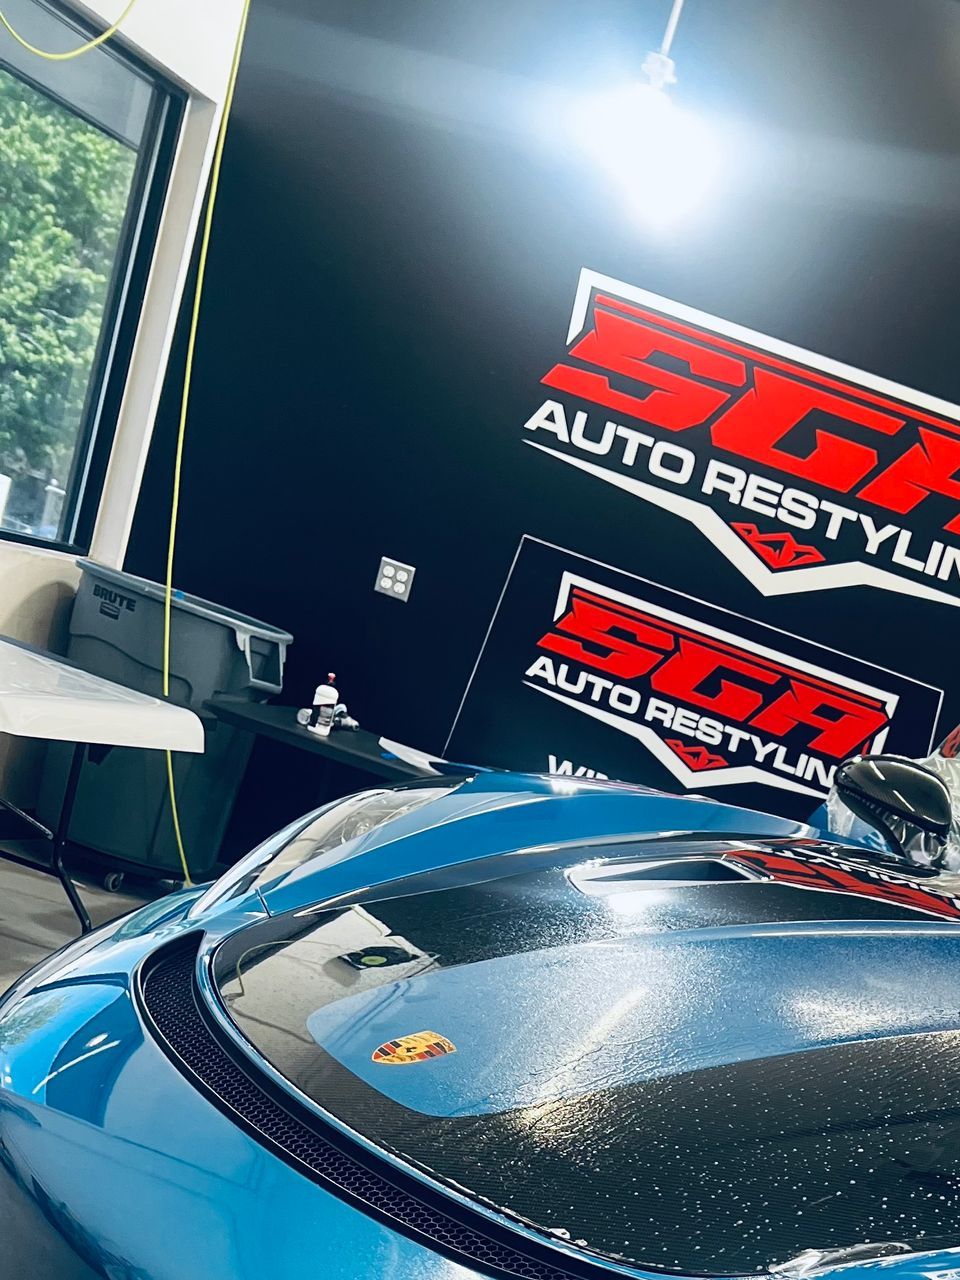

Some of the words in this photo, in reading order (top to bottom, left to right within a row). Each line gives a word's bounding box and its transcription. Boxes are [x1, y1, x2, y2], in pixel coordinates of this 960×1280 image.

[523, 399, 696, 485] AUTO
[92, 583, 137, 613] BRUTE
[525, 655, 641, 715] AUTO
[644, 697, 838, 787] RESTYLIN
[536, 597, 888, 759] SGA
